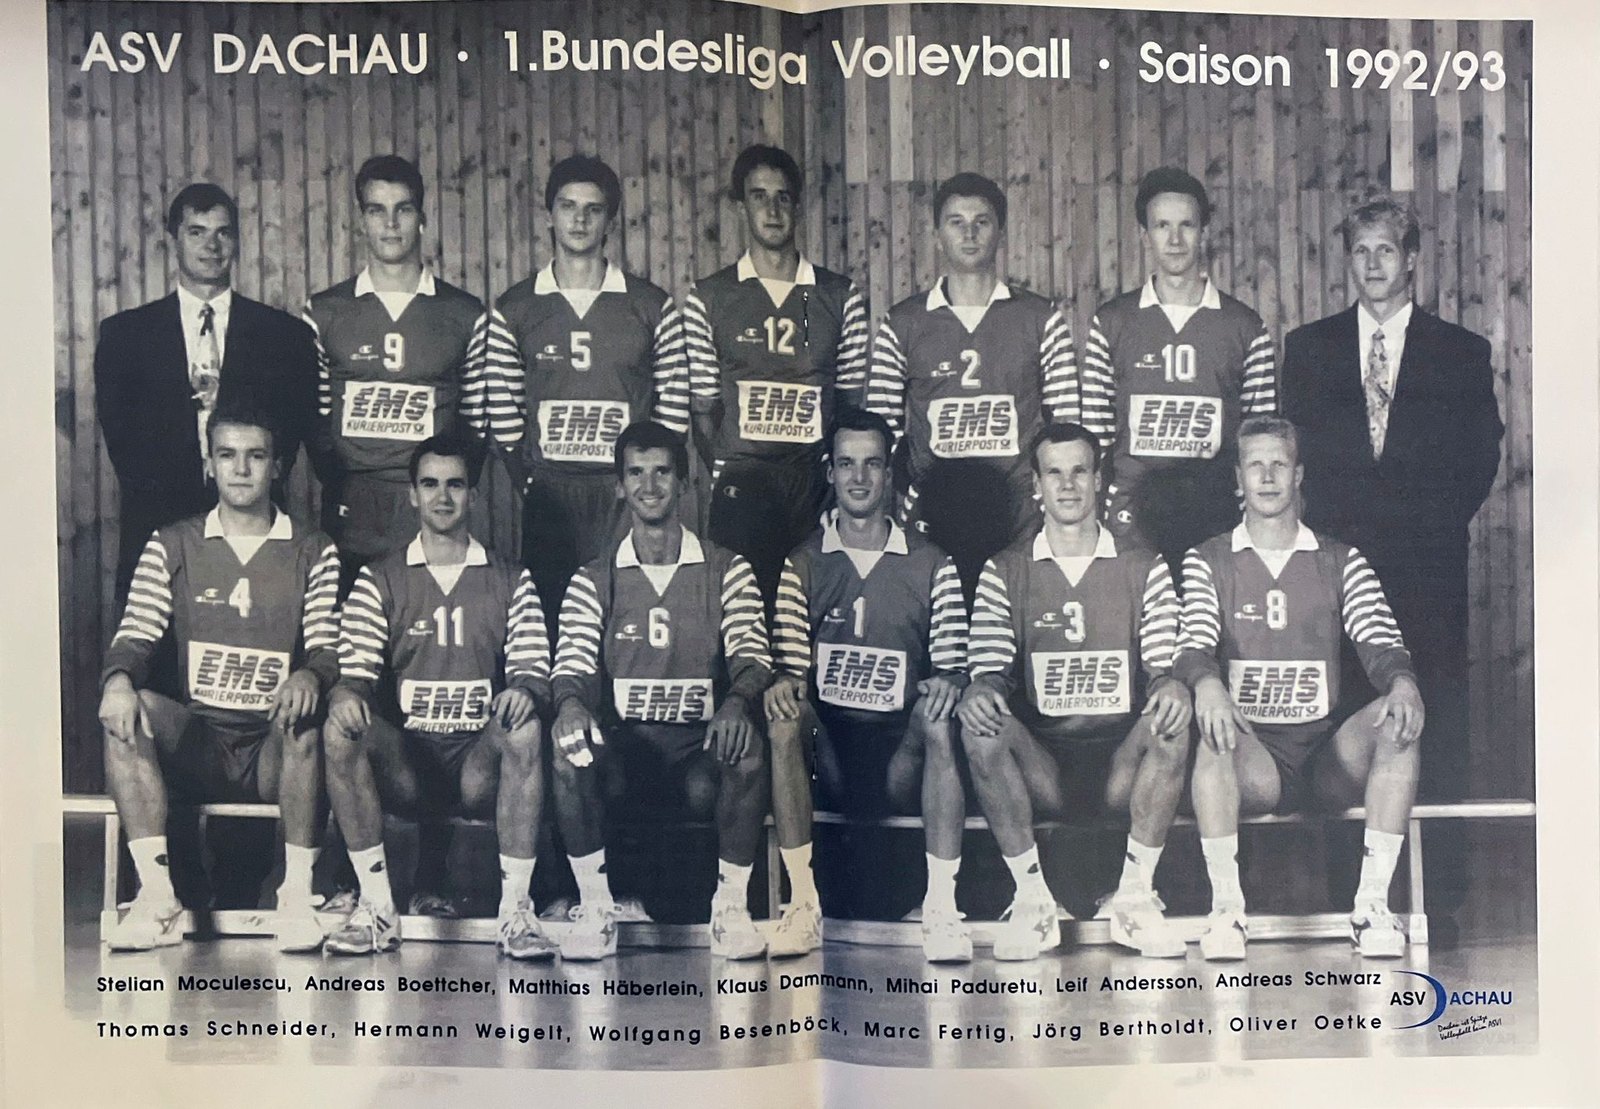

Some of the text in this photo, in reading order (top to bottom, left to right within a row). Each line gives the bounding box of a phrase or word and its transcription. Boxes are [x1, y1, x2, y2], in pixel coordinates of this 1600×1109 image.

[79, 29, 1507, 94] ASV DACHAU 1.Bundesliga Volleyball Saison 1992/93
[383, 332, 405, 371] 9
[570, 331, 592, 371] 5
[763, 316, 797, 355] 12
[959, 349, 982, 389] 2
[1161, 344, 1197, 383] 10
[350, 386, 429, 421] EMS
[748, 386, 822, 423] EMS
[937, 400, 1012, 440] EMS
[1138, 399, 1217, 439] EMS
[346, 420, 413, 434] KURIERPOST
[547, 405, 624, 443] EMS
[1134, 437, 1202, 452] KURIERPOST
[228, 577, 252, 618] 4
[853, 596, 866, 638] 1
[1265, 588, 1289, 630] 8
[432, 605, 465, 646] 11
[648, 607, 672, 648] 6
[1062, 601, 1086, 643] 3
[195, 648, 285, 692] EMS
[823, 649, 902, 692] EMS
[1043, 656, 1123, 697] EMS
[1238, 666, 1321, 709] EMS
[408, 685, 490, 720] EMS
[624, 683, 709, 722] EMS
[821, 688, 882, 706] KURERPOST
[1041, 694, 1107, 709] KURIERPOST
[97, 971, 1381, 998] Stelian Moculescu, Andreas Boettcher, Matthias Häberlein, Klaus Dammann, Mihai Paduretu, Leif Andersson, Andreas Schwarz
[1389, 991, 1426, 1006] ASV
[97, 1014, 1382, 1046] Thomas Schneider, Hermann Weigelt, Wolfgang Besenböck, Marc Fertig, Jörg Bertholdt, Oliver Oetke
